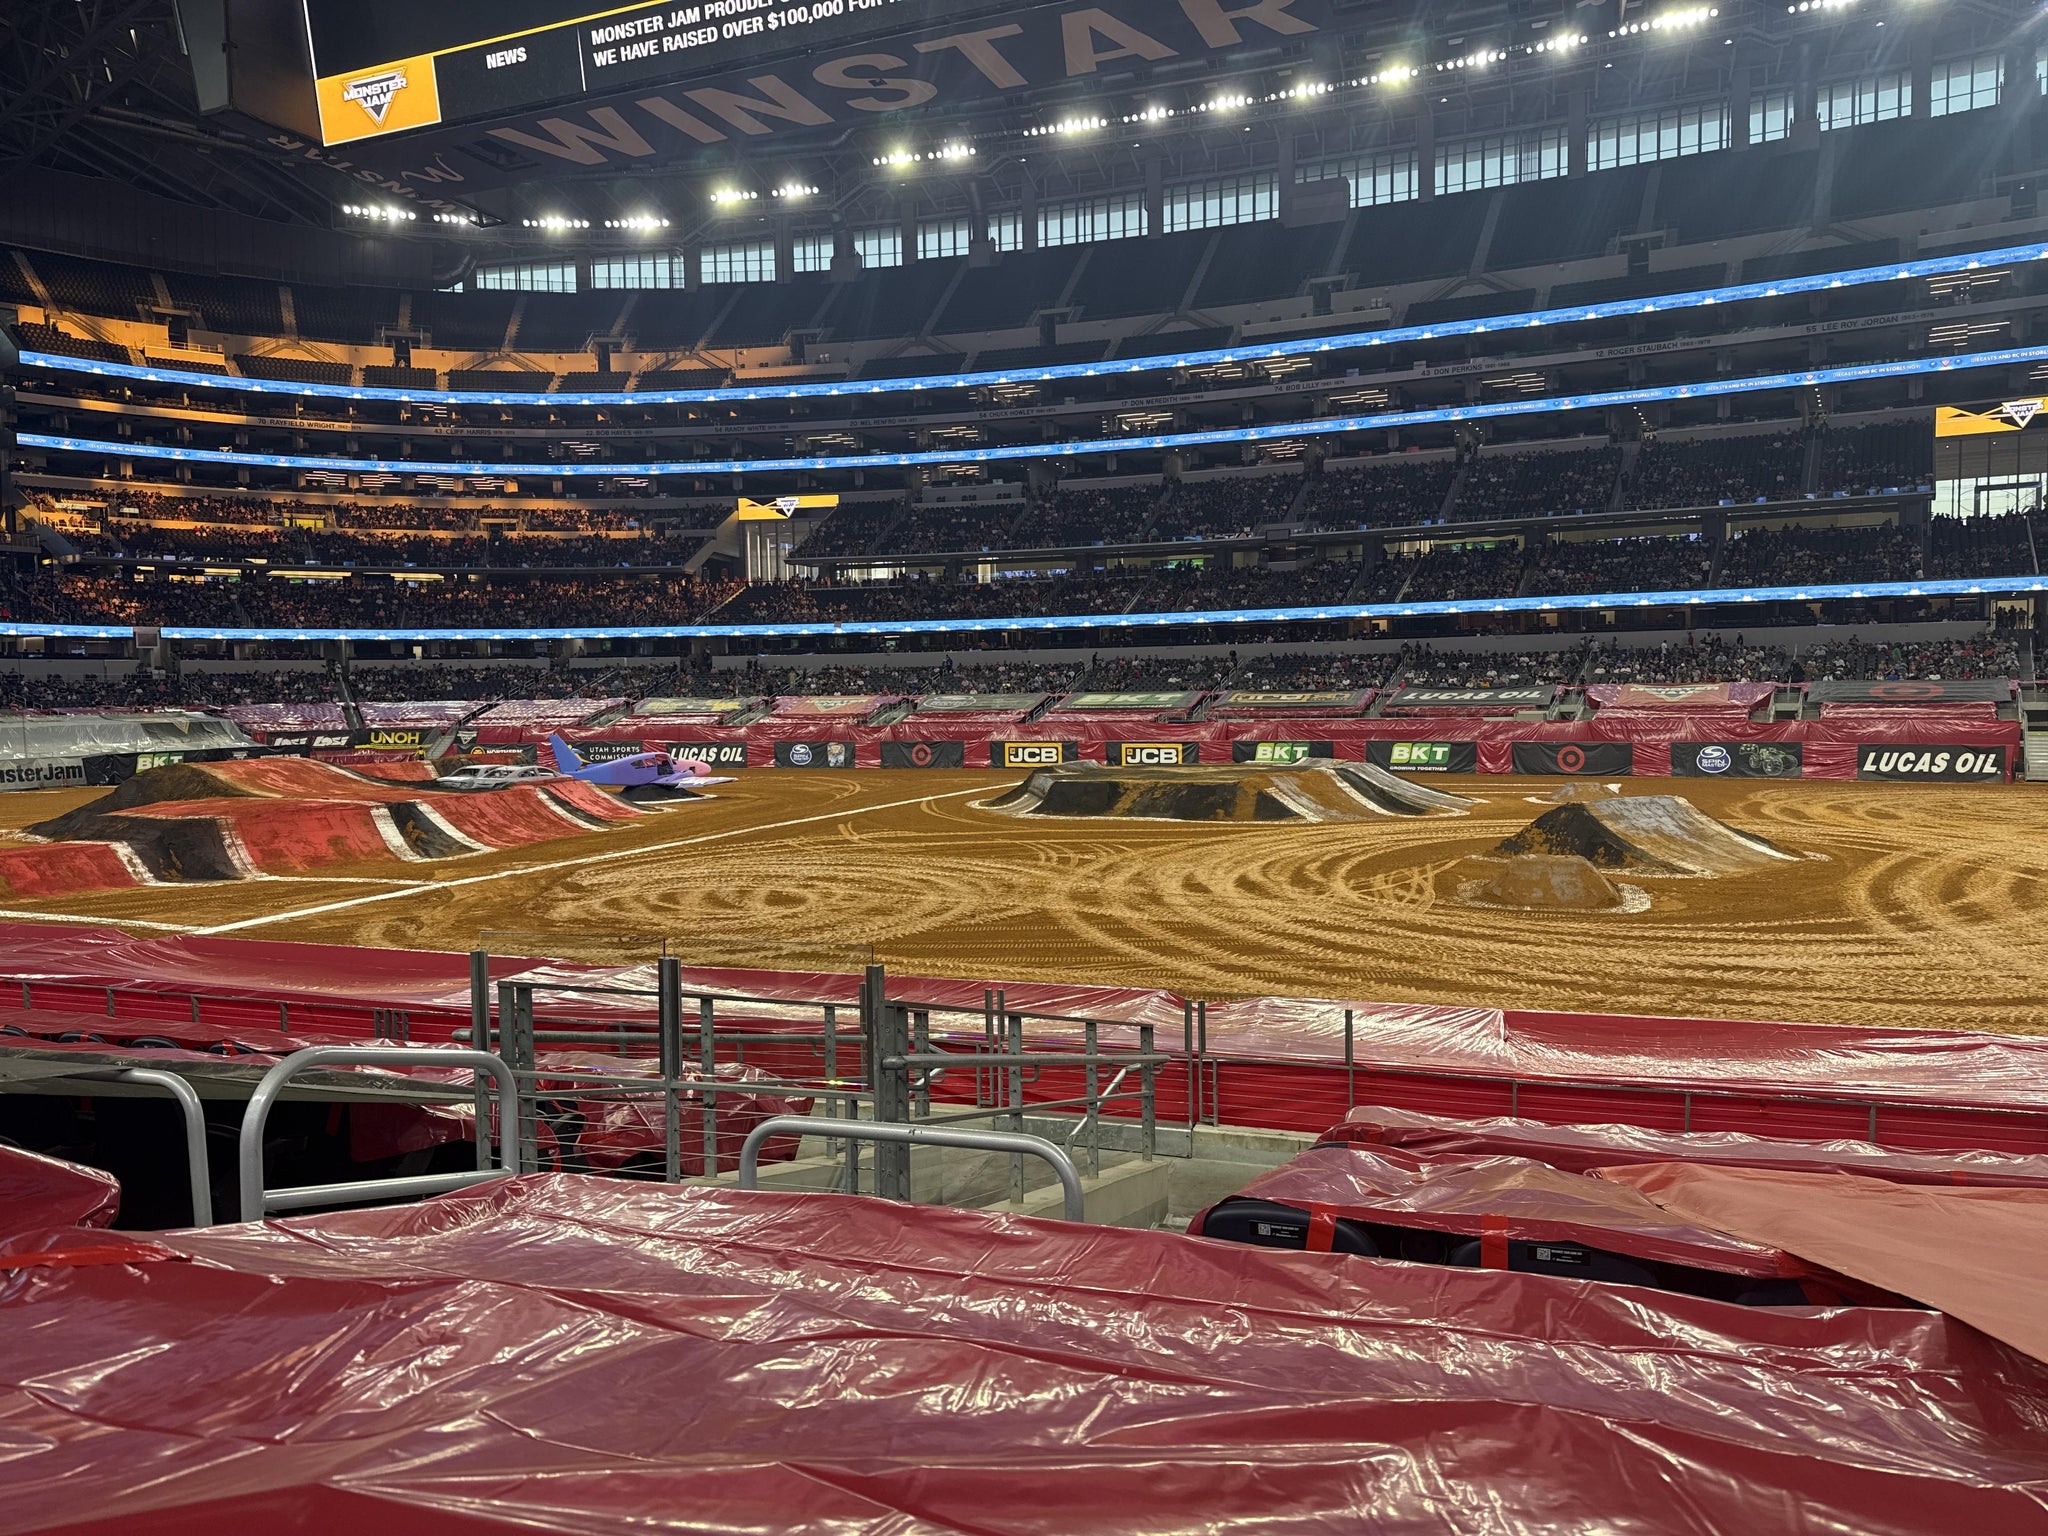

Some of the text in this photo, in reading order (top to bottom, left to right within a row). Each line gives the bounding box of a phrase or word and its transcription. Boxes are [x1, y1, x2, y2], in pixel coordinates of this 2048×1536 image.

[591, 16, 664, 45] MONSTER
[668, 6, 700, 28] JAM
[593, 48, 617, 67] WE
[620, 39, 659, 61] HAVE
[663, 27, 718, 52] RAISED
[722, 16, 764, 39] OVER
[767, 0, 844, 31] $100,000
[486, 47, 527, 69] NEWS
[343, 77, 408, 101] MONSTER
[485, 0, 1319, 166] WINSTAR
[362, 91, 393, 108] JAM
[1821, 323, 1838, 331] LEE
[1841, 321, 1857, 329] ROY
[1861, 316, 1899, 327] JORDAN
[1608, 348, 1635, 356] ROGER
[1637, 342, 1678, 353] STAUBACH
[1434, 368, 1449, 376] DON
[1452, 364, 1482, 374] PERKINS
[1146, 396, 1178, 405] MEREDITH
[269, 419, 305, 427] RAYFIELD
[306, 421, 336, 429] WRIGHT
[1402, 692, 1494, 700] LUCAS
[371, 731, 420, 744] UNOH
[671, 747, 718, 762] LUCAS
[1010, 748, 1058, 763] JCB
[1126, 749, 1178, 764] JCB
[1257, 745, 1309, 760] BKT
[1391, 746, 1449, 761] BKT
[138, 755, 184, 770] BKT
[1863, 752, 1950, 773] LUCAS
